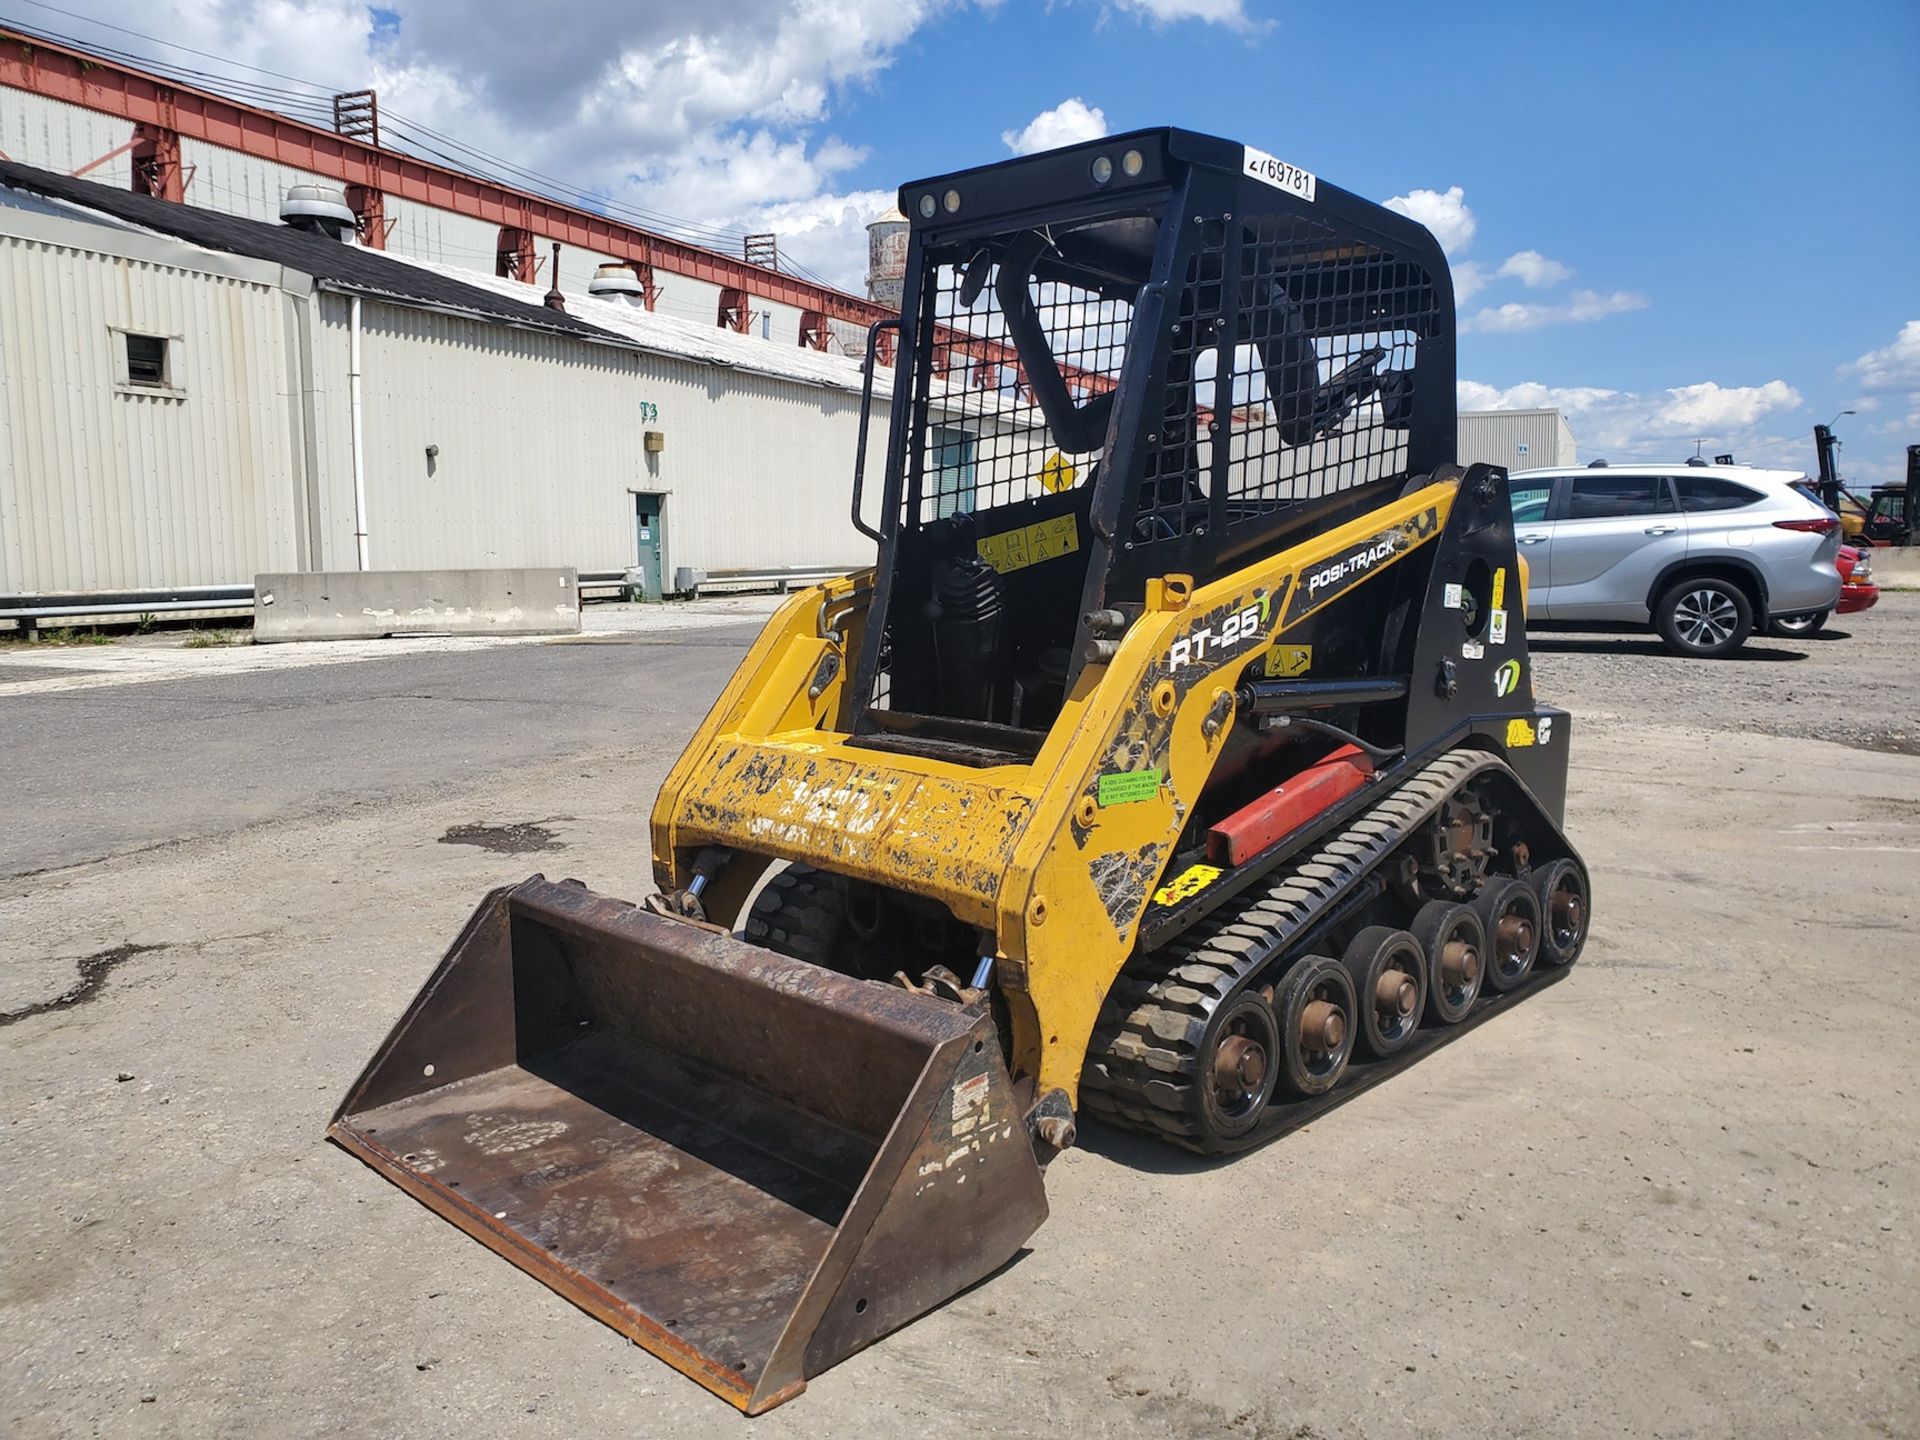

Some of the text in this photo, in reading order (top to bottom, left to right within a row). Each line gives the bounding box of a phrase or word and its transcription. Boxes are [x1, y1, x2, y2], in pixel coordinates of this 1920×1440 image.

[1249, 159, 1309, 193] 2769781
[639, 401, 658, 418] T3
[1308, 537, 1395, 592] POSI-TRACK
[1169, 606, 1259, 674] RT-25
